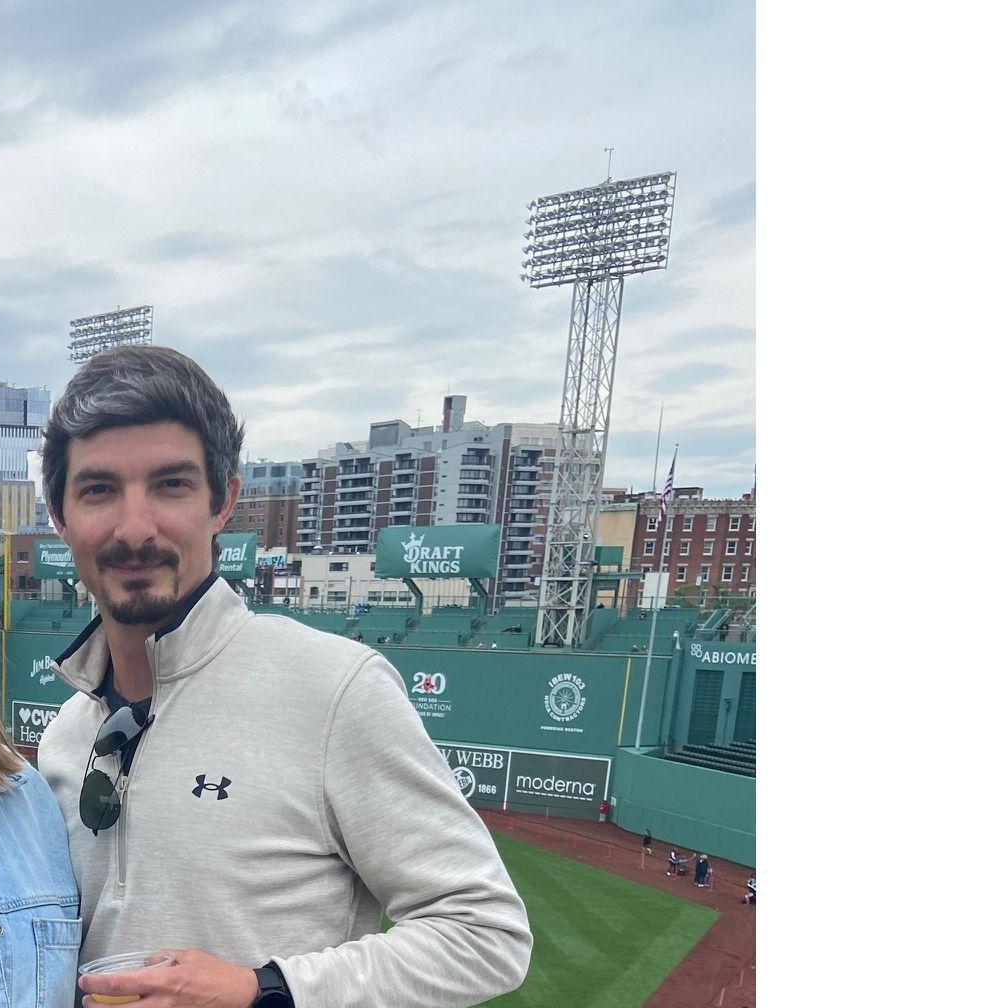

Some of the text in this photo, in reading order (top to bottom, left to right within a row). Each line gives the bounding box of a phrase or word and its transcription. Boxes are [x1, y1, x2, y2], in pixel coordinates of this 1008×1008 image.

[404, 546, 464, 563] DRAFT
[219, 563, 243, 572] Rental
[410, 560, 461, 574] KINGS
[702, 651, 756, 664] ABIOME
[31, 659, 44, 677] JIM
[549, 673, 585, 689] IBEW 103
[31, 709, 57, 726] CVS
[457, 750, 503, 769] WEBB
[478, 783, 496, 794] 1866
[517, 775, 594, 795] moderna
